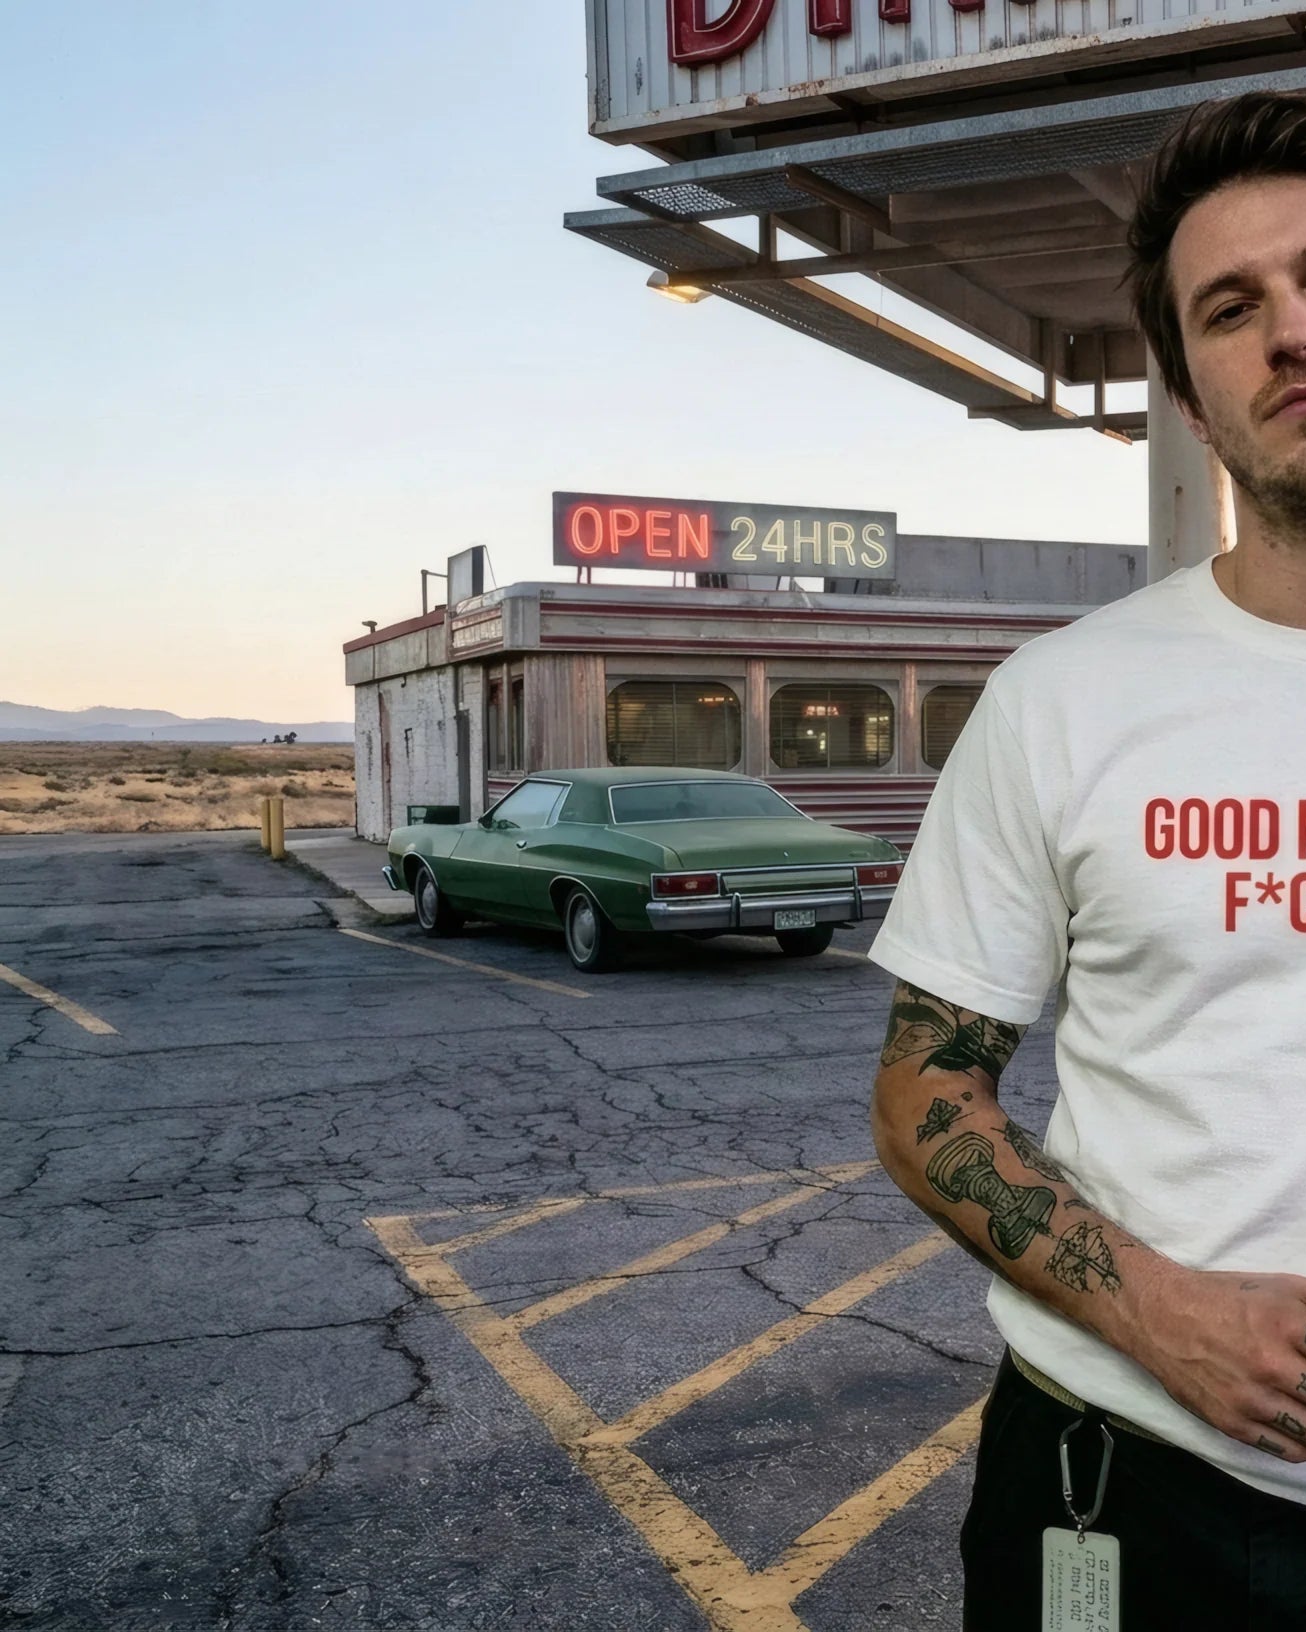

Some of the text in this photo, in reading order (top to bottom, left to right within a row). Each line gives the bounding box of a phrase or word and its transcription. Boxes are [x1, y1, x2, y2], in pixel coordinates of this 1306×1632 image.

[571, 506, 888, 569] OPEN 24HRS
[1144, 797, 1280, 860] GOOD
